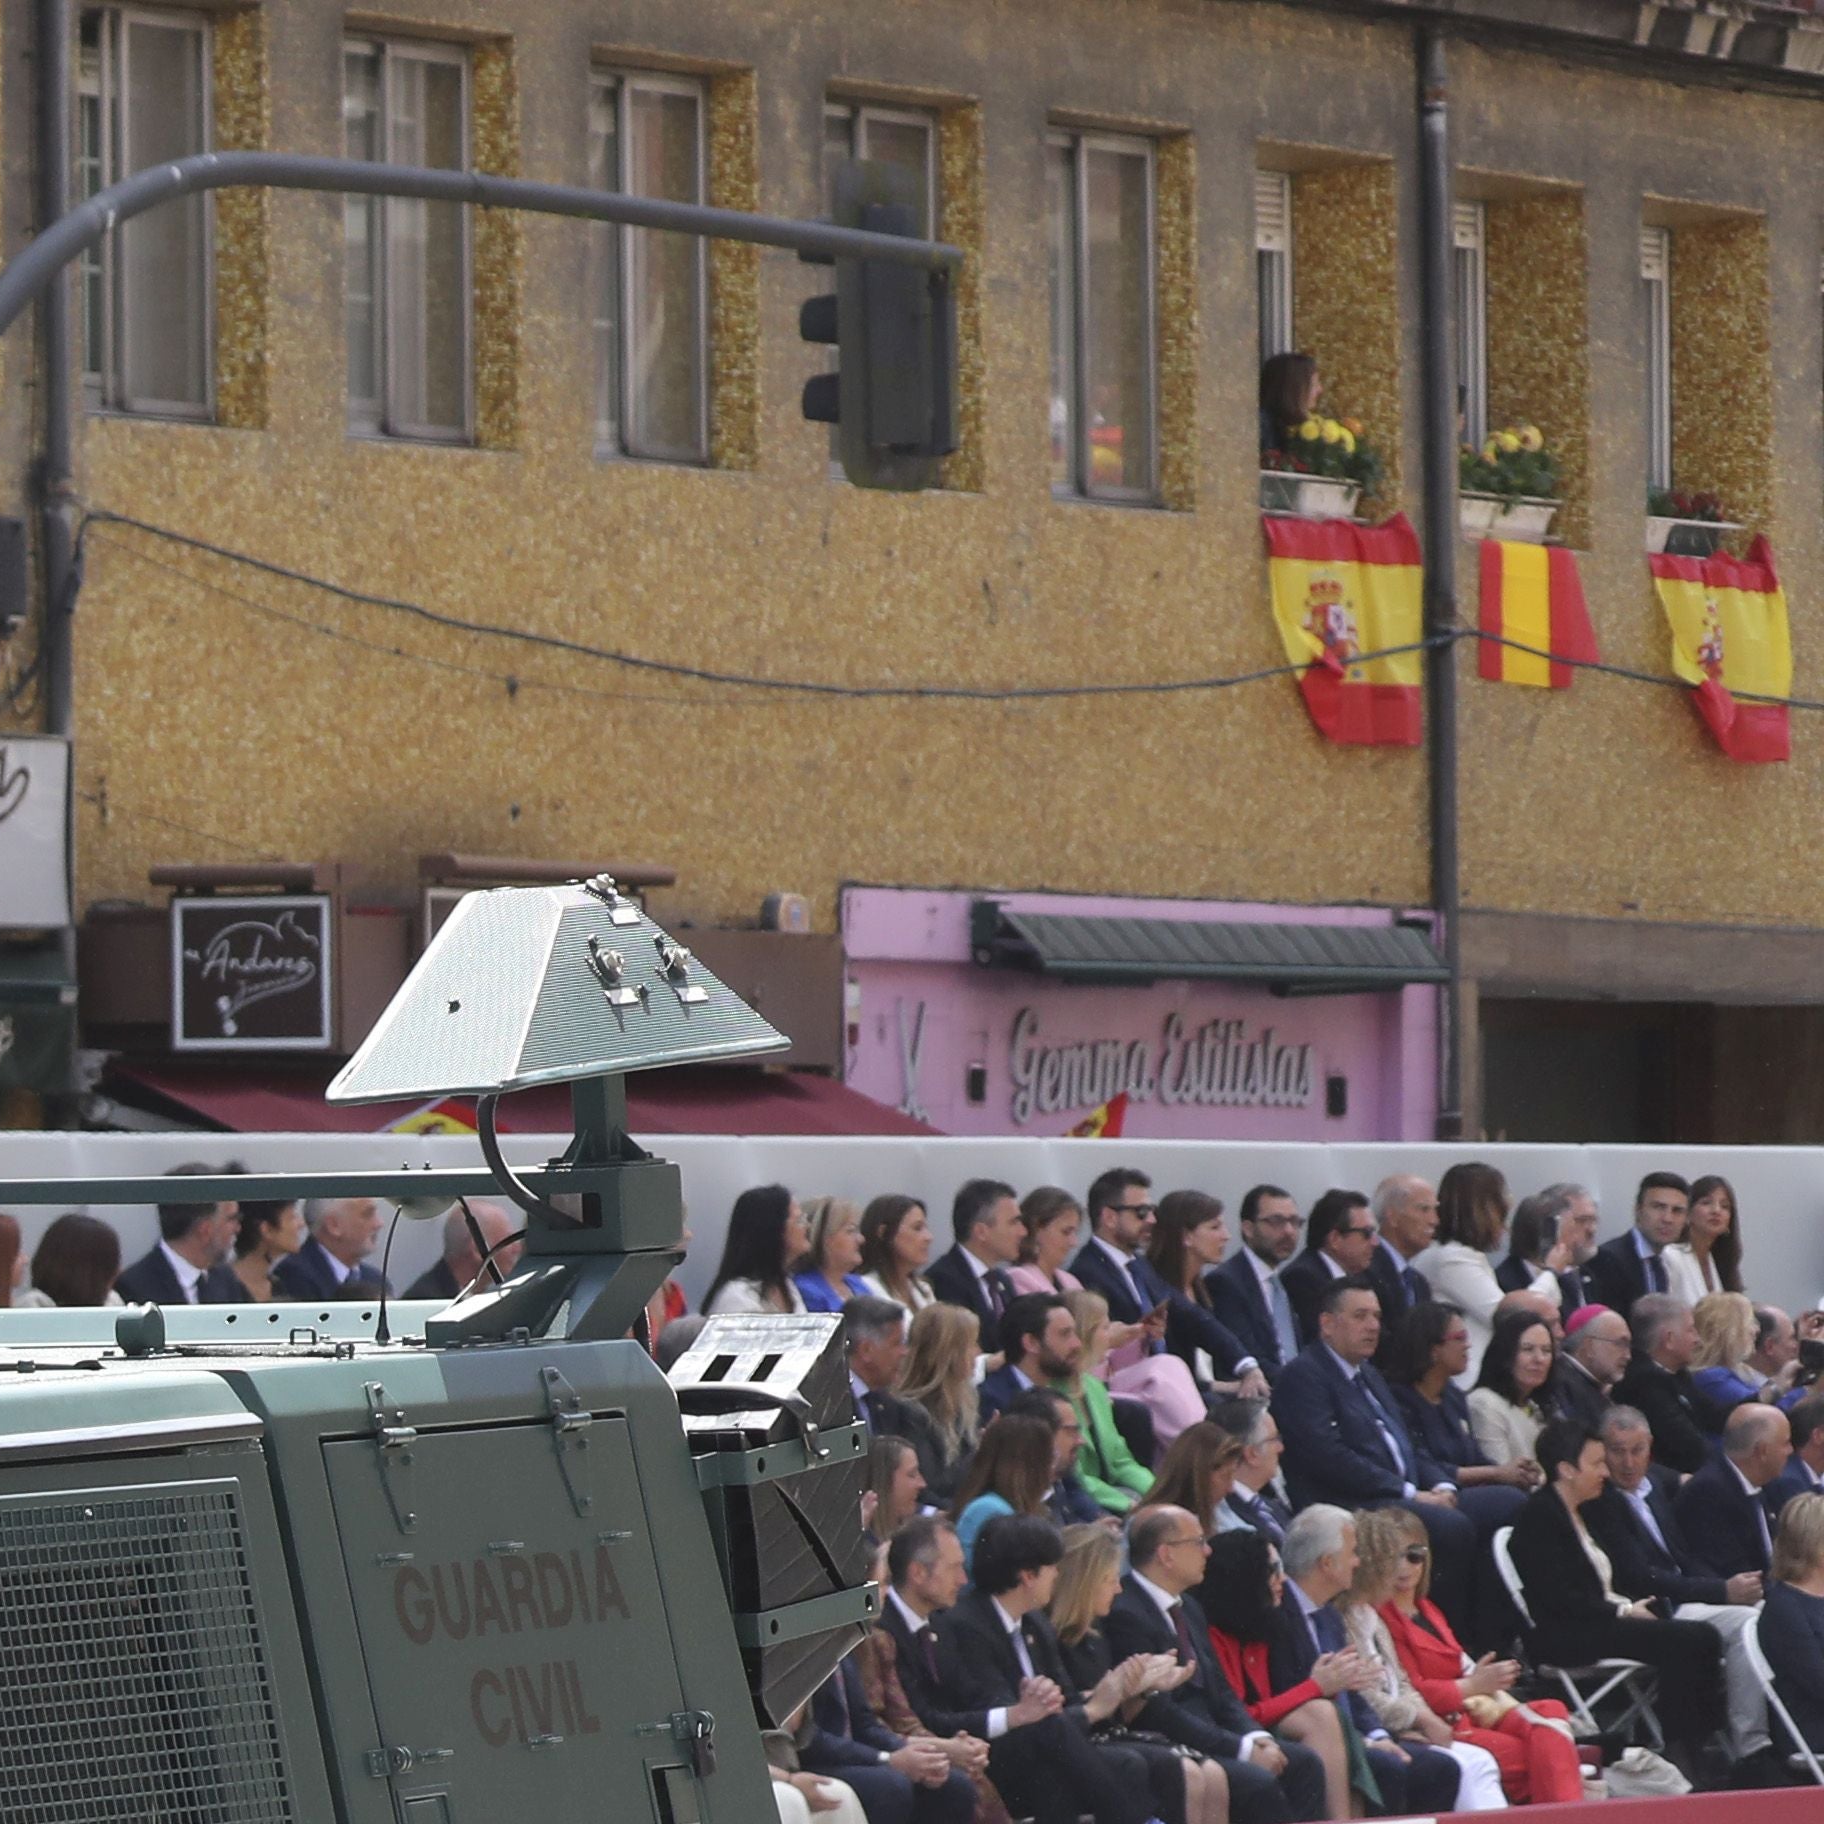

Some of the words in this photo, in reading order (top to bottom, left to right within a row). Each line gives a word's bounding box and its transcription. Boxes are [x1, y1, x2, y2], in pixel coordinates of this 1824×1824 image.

[1010, 1007, 1154, 1127] Gemma
[1158, 1011, 1317, 1108] Estilistas
[392, 1545, 631, 1645] GUARDIA
[470, 1660, 601, 1748] CIVIL
